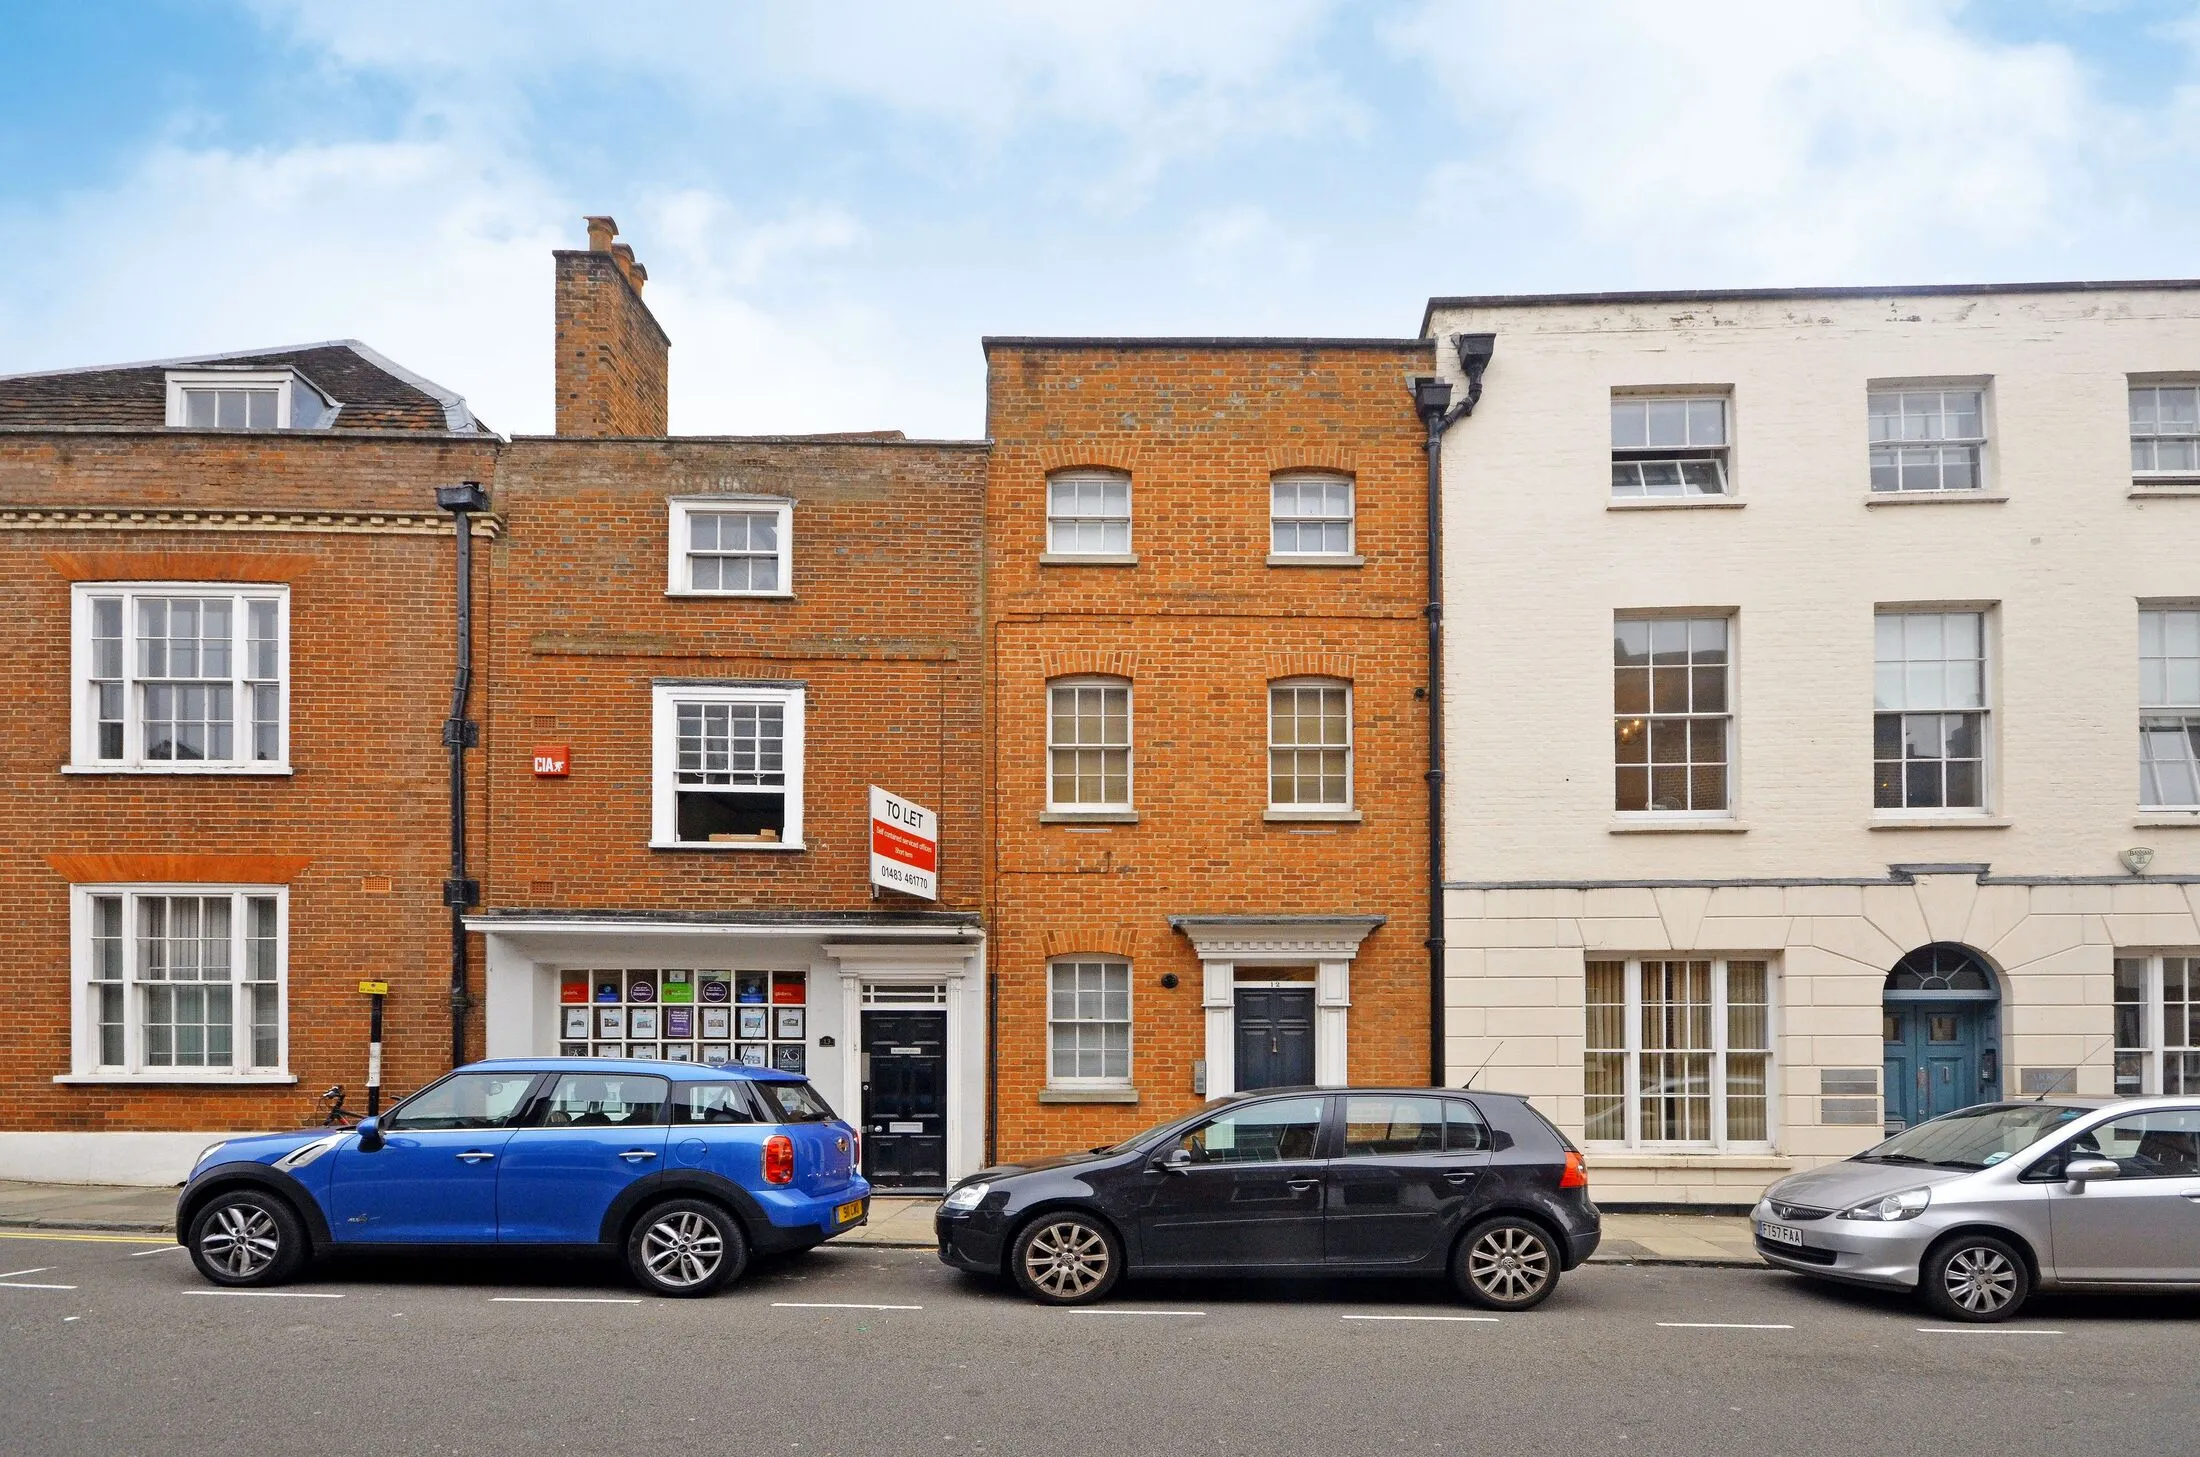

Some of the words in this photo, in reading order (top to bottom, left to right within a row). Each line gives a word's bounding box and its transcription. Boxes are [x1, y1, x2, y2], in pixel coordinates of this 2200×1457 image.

[534, 756, 554, 773] CIA
[886, 799, 901, 820] TO
[903, 807, 924, 829] LET
[881, 865, 903, 882] 01483
[904, 872, 928, 889] 461770
[1763, 1223, 1781, 1239] FT57
[1783, 1228, 1801, 1244] FAA
